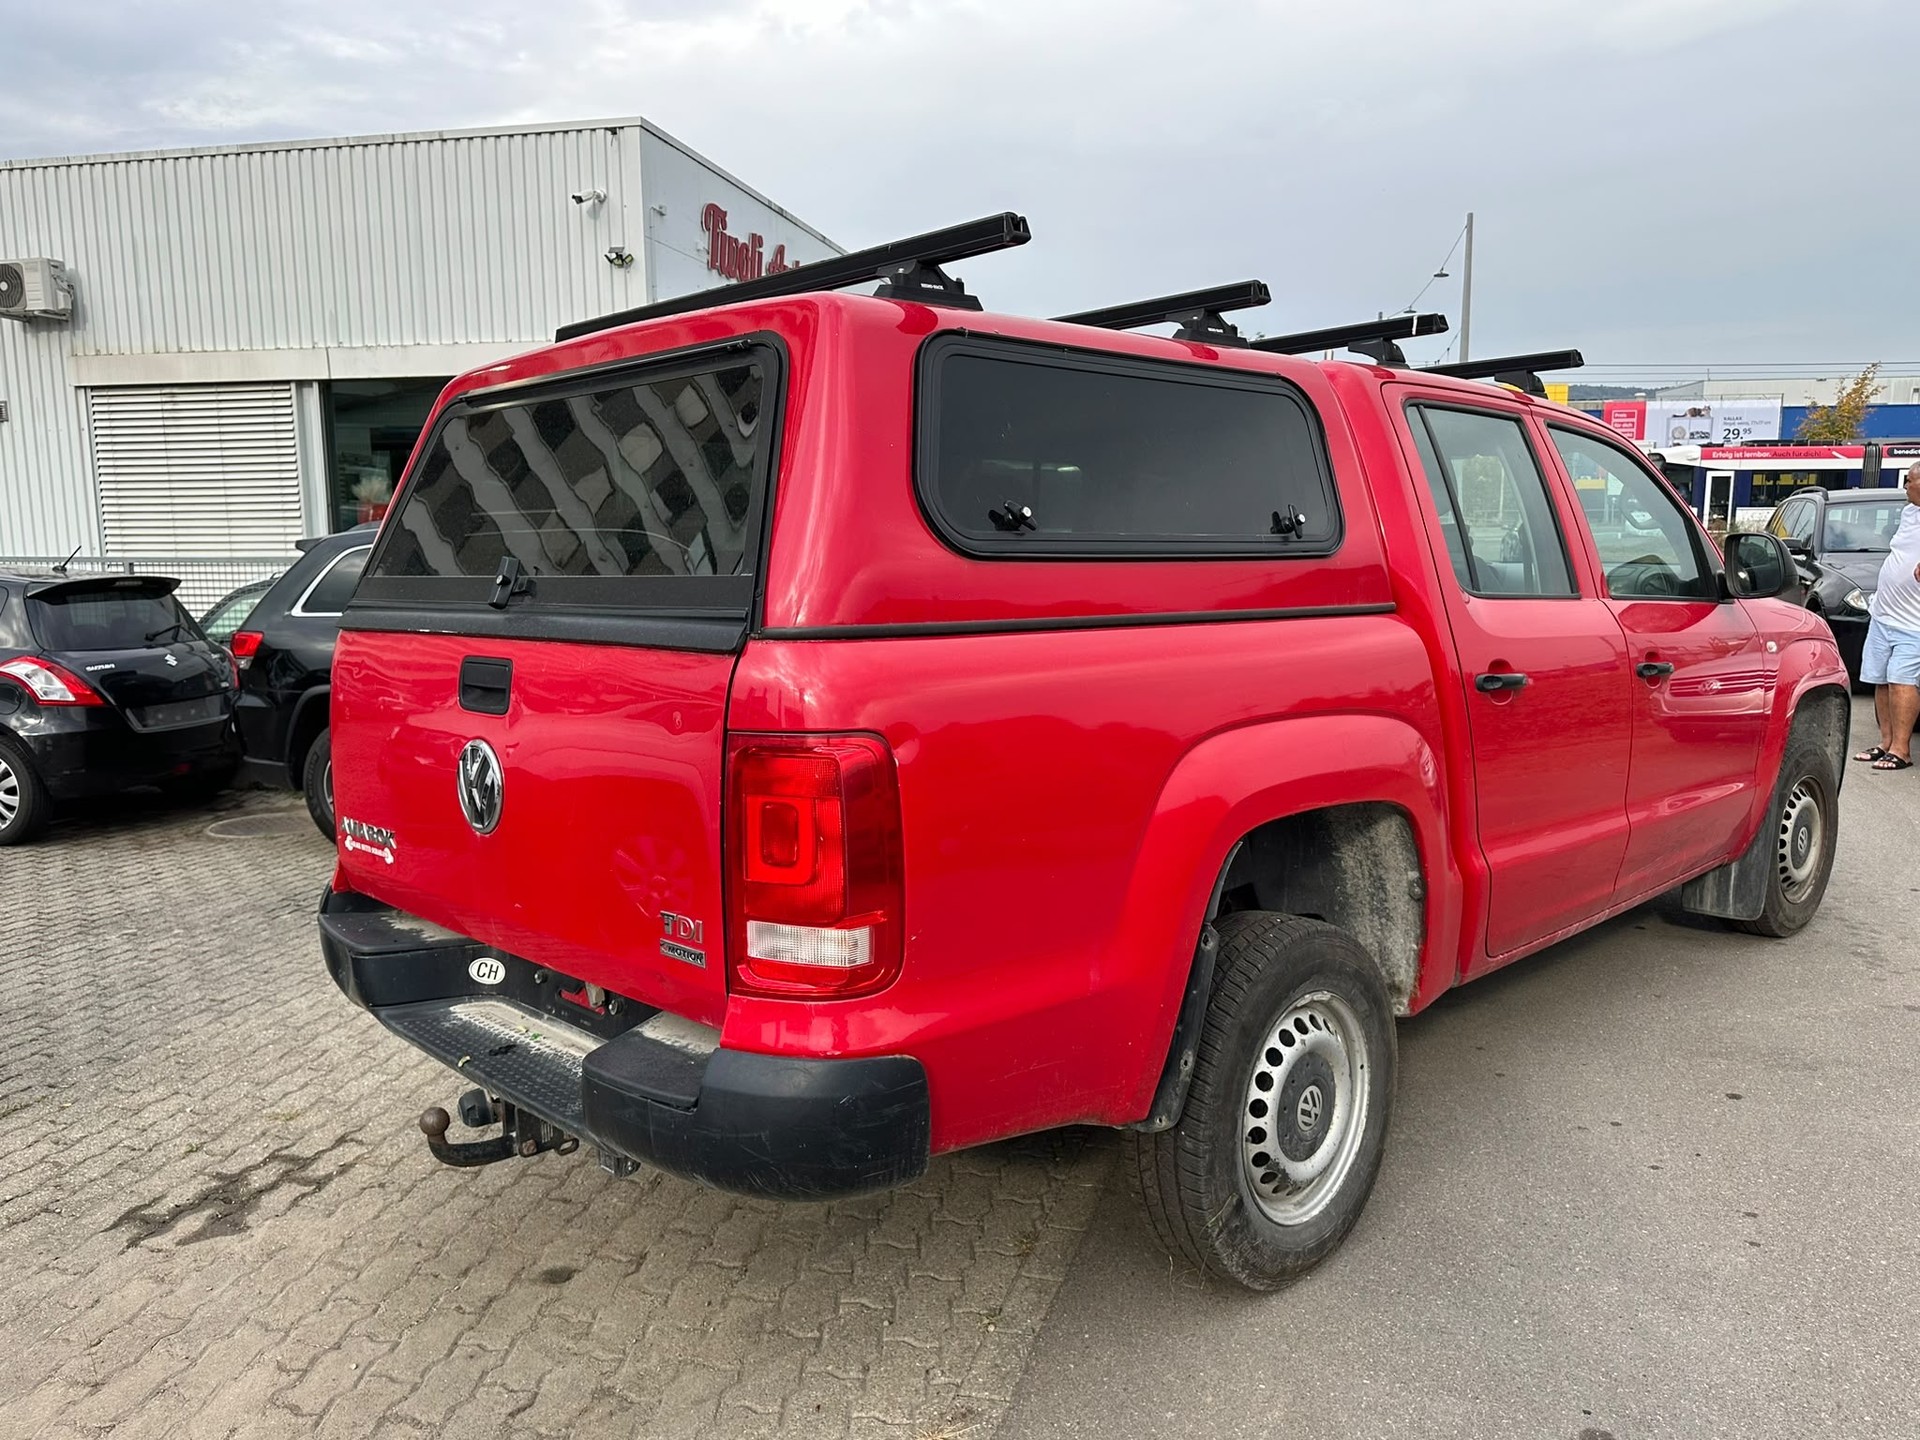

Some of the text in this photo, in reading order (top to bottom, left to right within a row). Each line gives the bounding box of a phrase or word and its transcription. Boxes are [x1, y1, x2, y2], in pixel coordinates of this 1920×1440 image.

[702, 203, 764, 282] Tivoli
[1712, 450, 1733, 459] Erfolg
[1734, 450, 1743, 458] ist
[1743, 450, 1772, 458] lernbar.
[341, 816, 398, 849] AMAROK
[660, 910, 703, 945] TDI
[476, 961, 499, 981] CH
